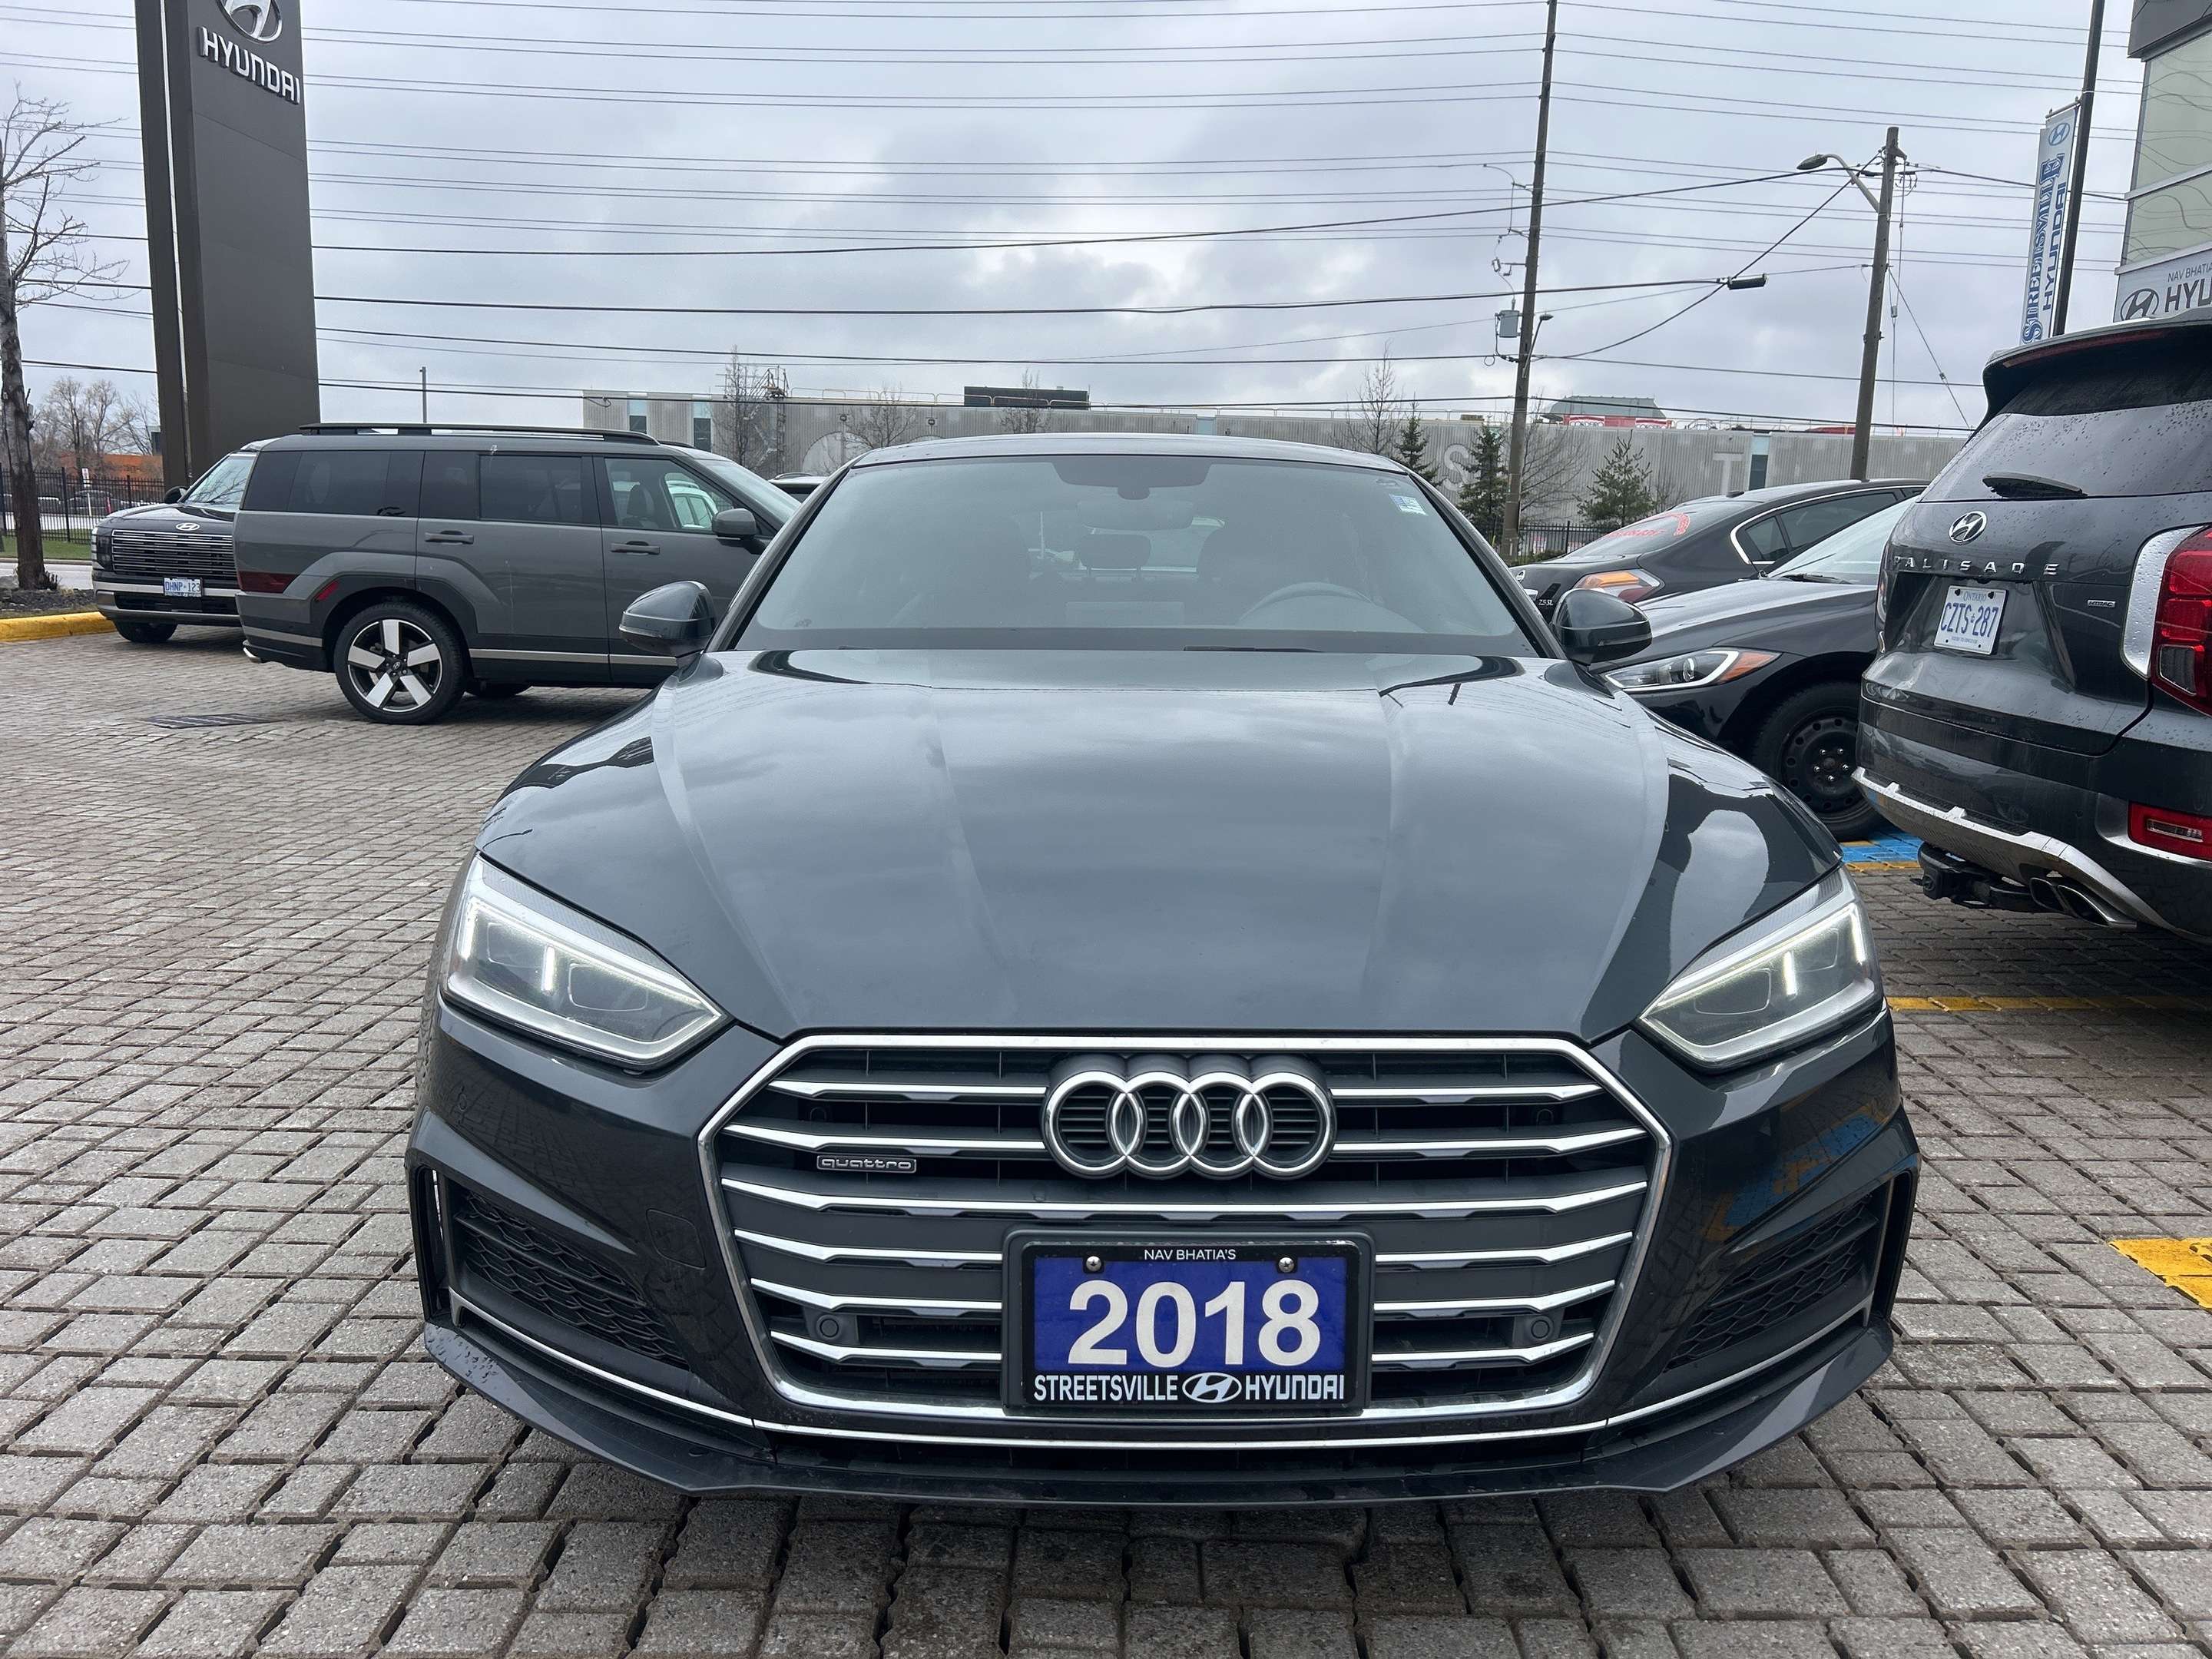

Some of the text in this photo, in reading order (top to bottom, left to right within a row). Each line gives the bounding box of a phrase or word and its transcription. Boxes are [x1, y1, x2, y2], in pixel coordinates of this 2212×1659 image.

[200, 25, 301, 105] HYUNDAI
[2042, 182, 2067, 311] HYUNDAI
[2167, 270, 2184, 283] NAV
[1893, 555, 2060, 575] PALISADE
[821, 1158, 912, 1169] quattro
[1144, 1249, 1237, 1260] NAV BHATIA'S
[1068, 1279, 1321, 1368] 2018
[1034, 1373, 1345, 1402] STREETSVILLE HYUNDAI
